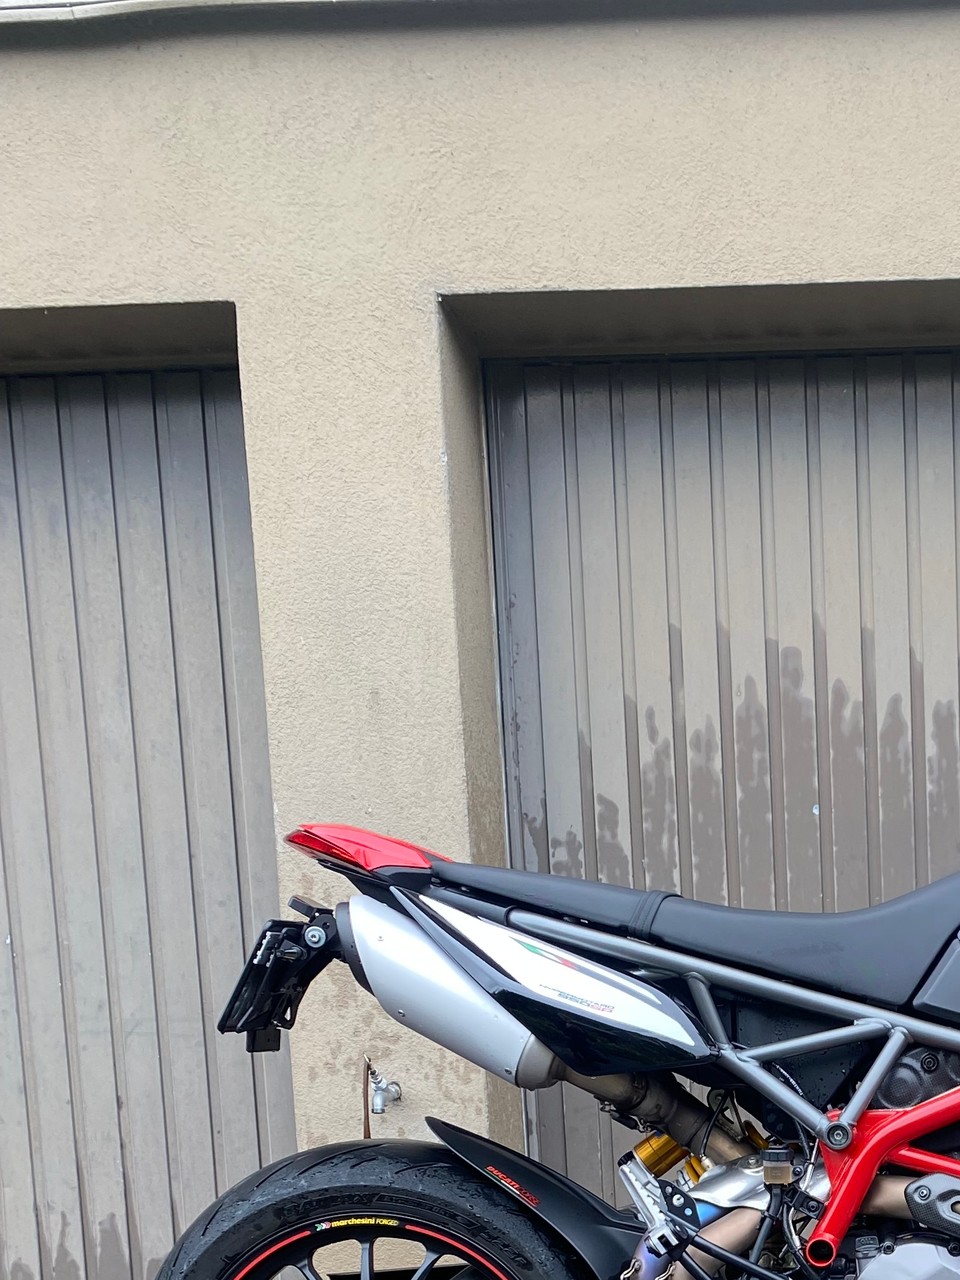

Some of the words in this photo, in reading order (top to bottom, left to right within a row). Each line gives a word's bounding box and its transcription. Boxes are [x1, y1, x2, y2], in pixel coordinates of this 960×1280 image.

[485, 1166, 521, 1190] DUCATI
[331, 1217, 375, 1228] marchesini
[375, 1218, 399, 1227] FORGED
